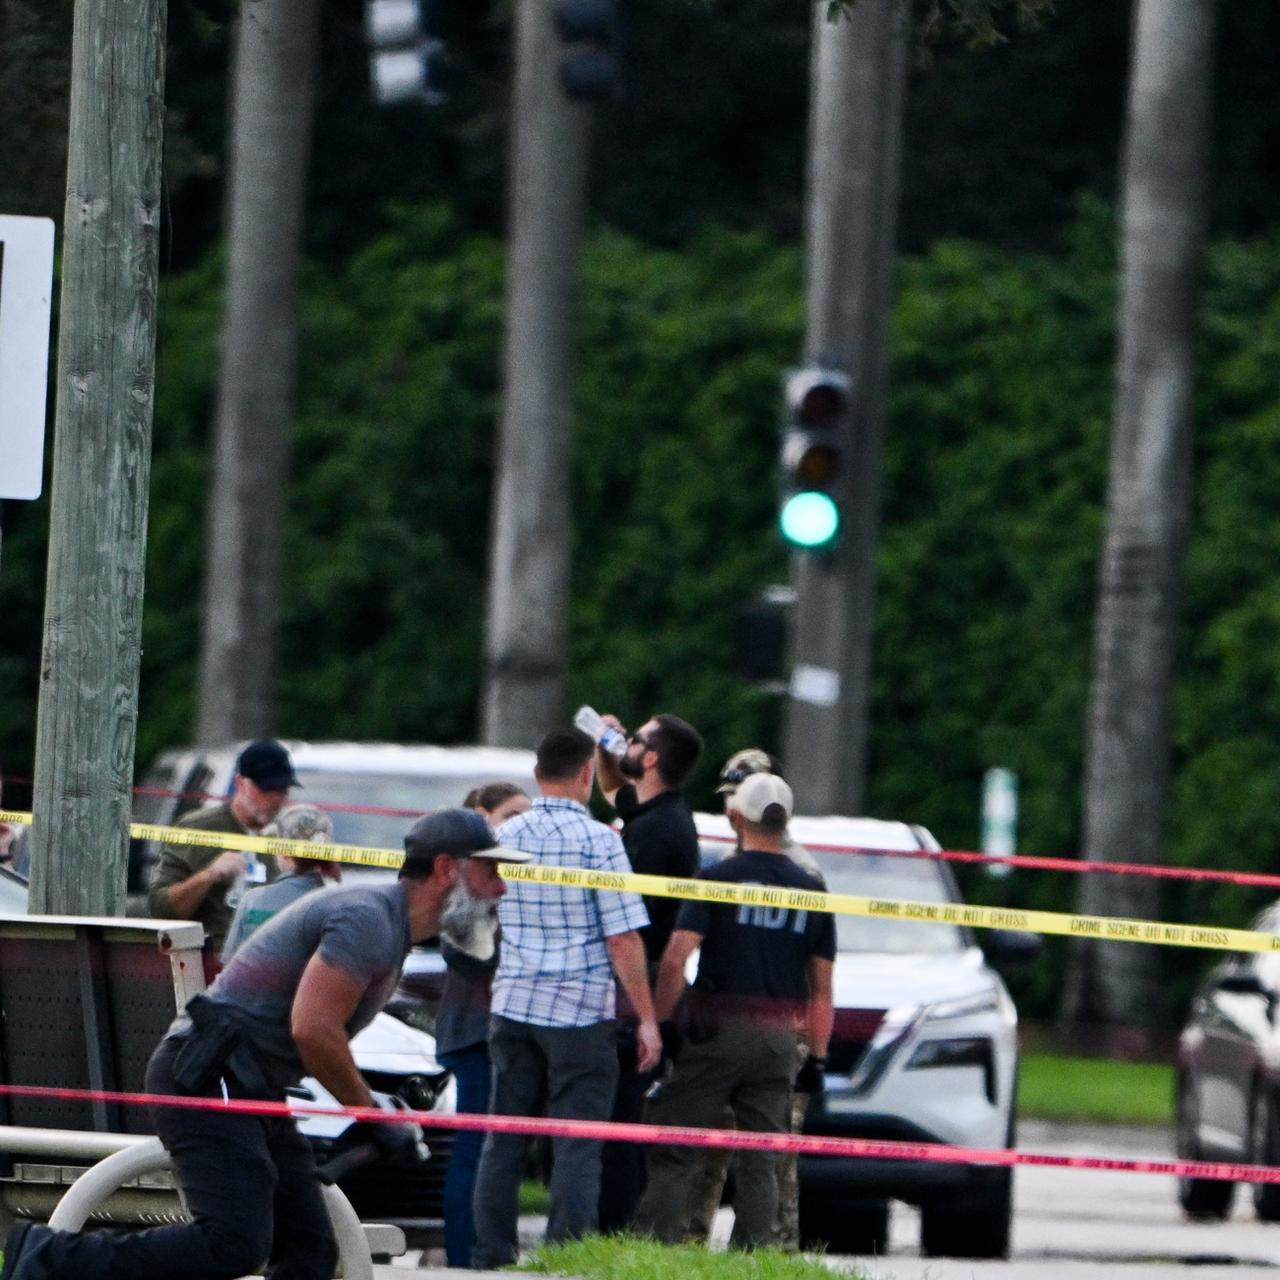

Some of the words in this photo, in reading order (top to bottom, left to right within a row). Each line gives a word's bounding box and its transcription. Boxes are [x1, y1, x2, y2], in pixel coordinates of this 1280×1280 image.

[504, 865, 536, 880] SCENE
[542, 868, 556, 882] DO
[562, 869, 583, 884] NOT
[587, 872, 626, 889] CROSS
[667, 880, 699, 895] CRIME
[705, 883, 736, 899] SCENE
[743, 888, 758, 901] DO
[763, 890, 784, 904] NOT
[789, 891, 826, 909] CROSS
[869, 899, 899, 915] CRIME
[905, 903, 937, 919] SCENE
[944, 907, 959, 921] DO
[964, 908, 985, 924] NOT
[990, 909, 1027, 927] CROSS
[1070, 919, 1101, 934] CRIME
[1107, 922, 1140, 937] SCENE
[1146, 925, 1160, 939] DO
[1165, 927, 1185, 941] NOT
[1191, 928, 1229, 945] CROSS
